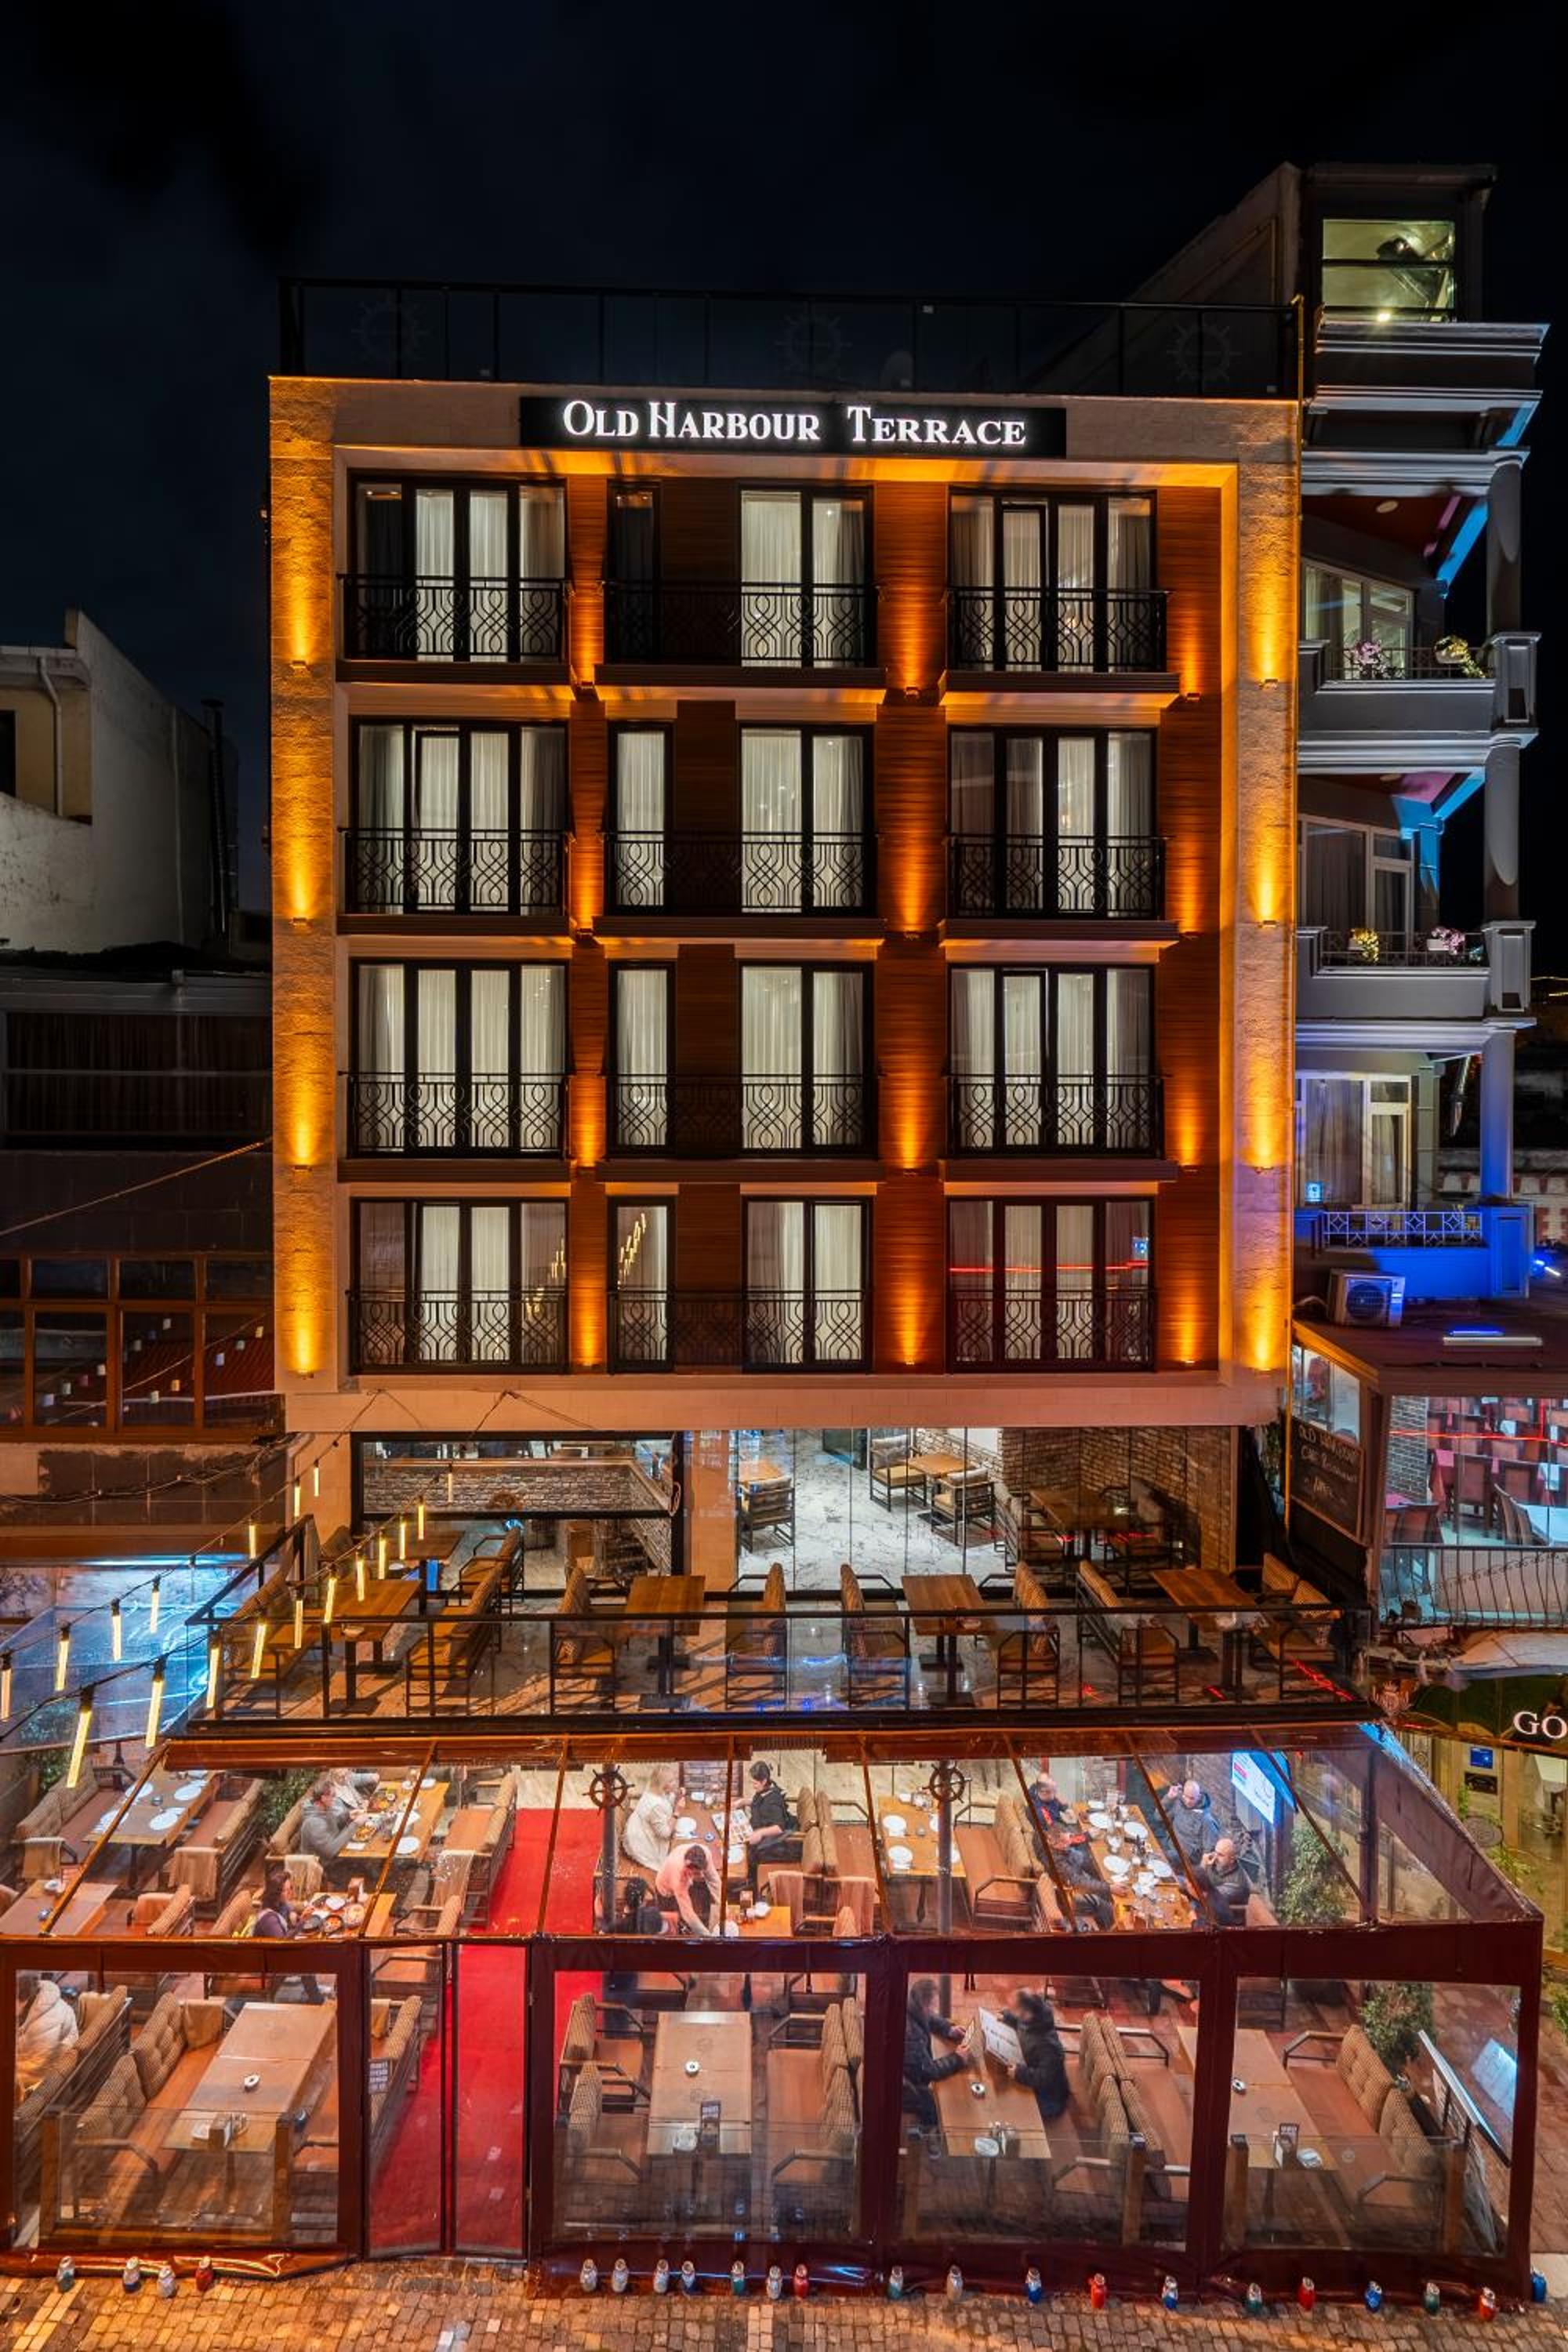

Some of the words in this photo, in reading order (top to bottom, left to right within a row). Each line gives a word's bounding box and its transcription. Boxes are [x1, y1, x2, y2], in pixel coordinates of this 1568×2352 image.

[561, 399, 639, 437] OLD
[648, 401, 820, 441] HARBOUR
[847, 405, 1026, 445] TERRACE
[1513, 1711, 1567, 1739] GO
